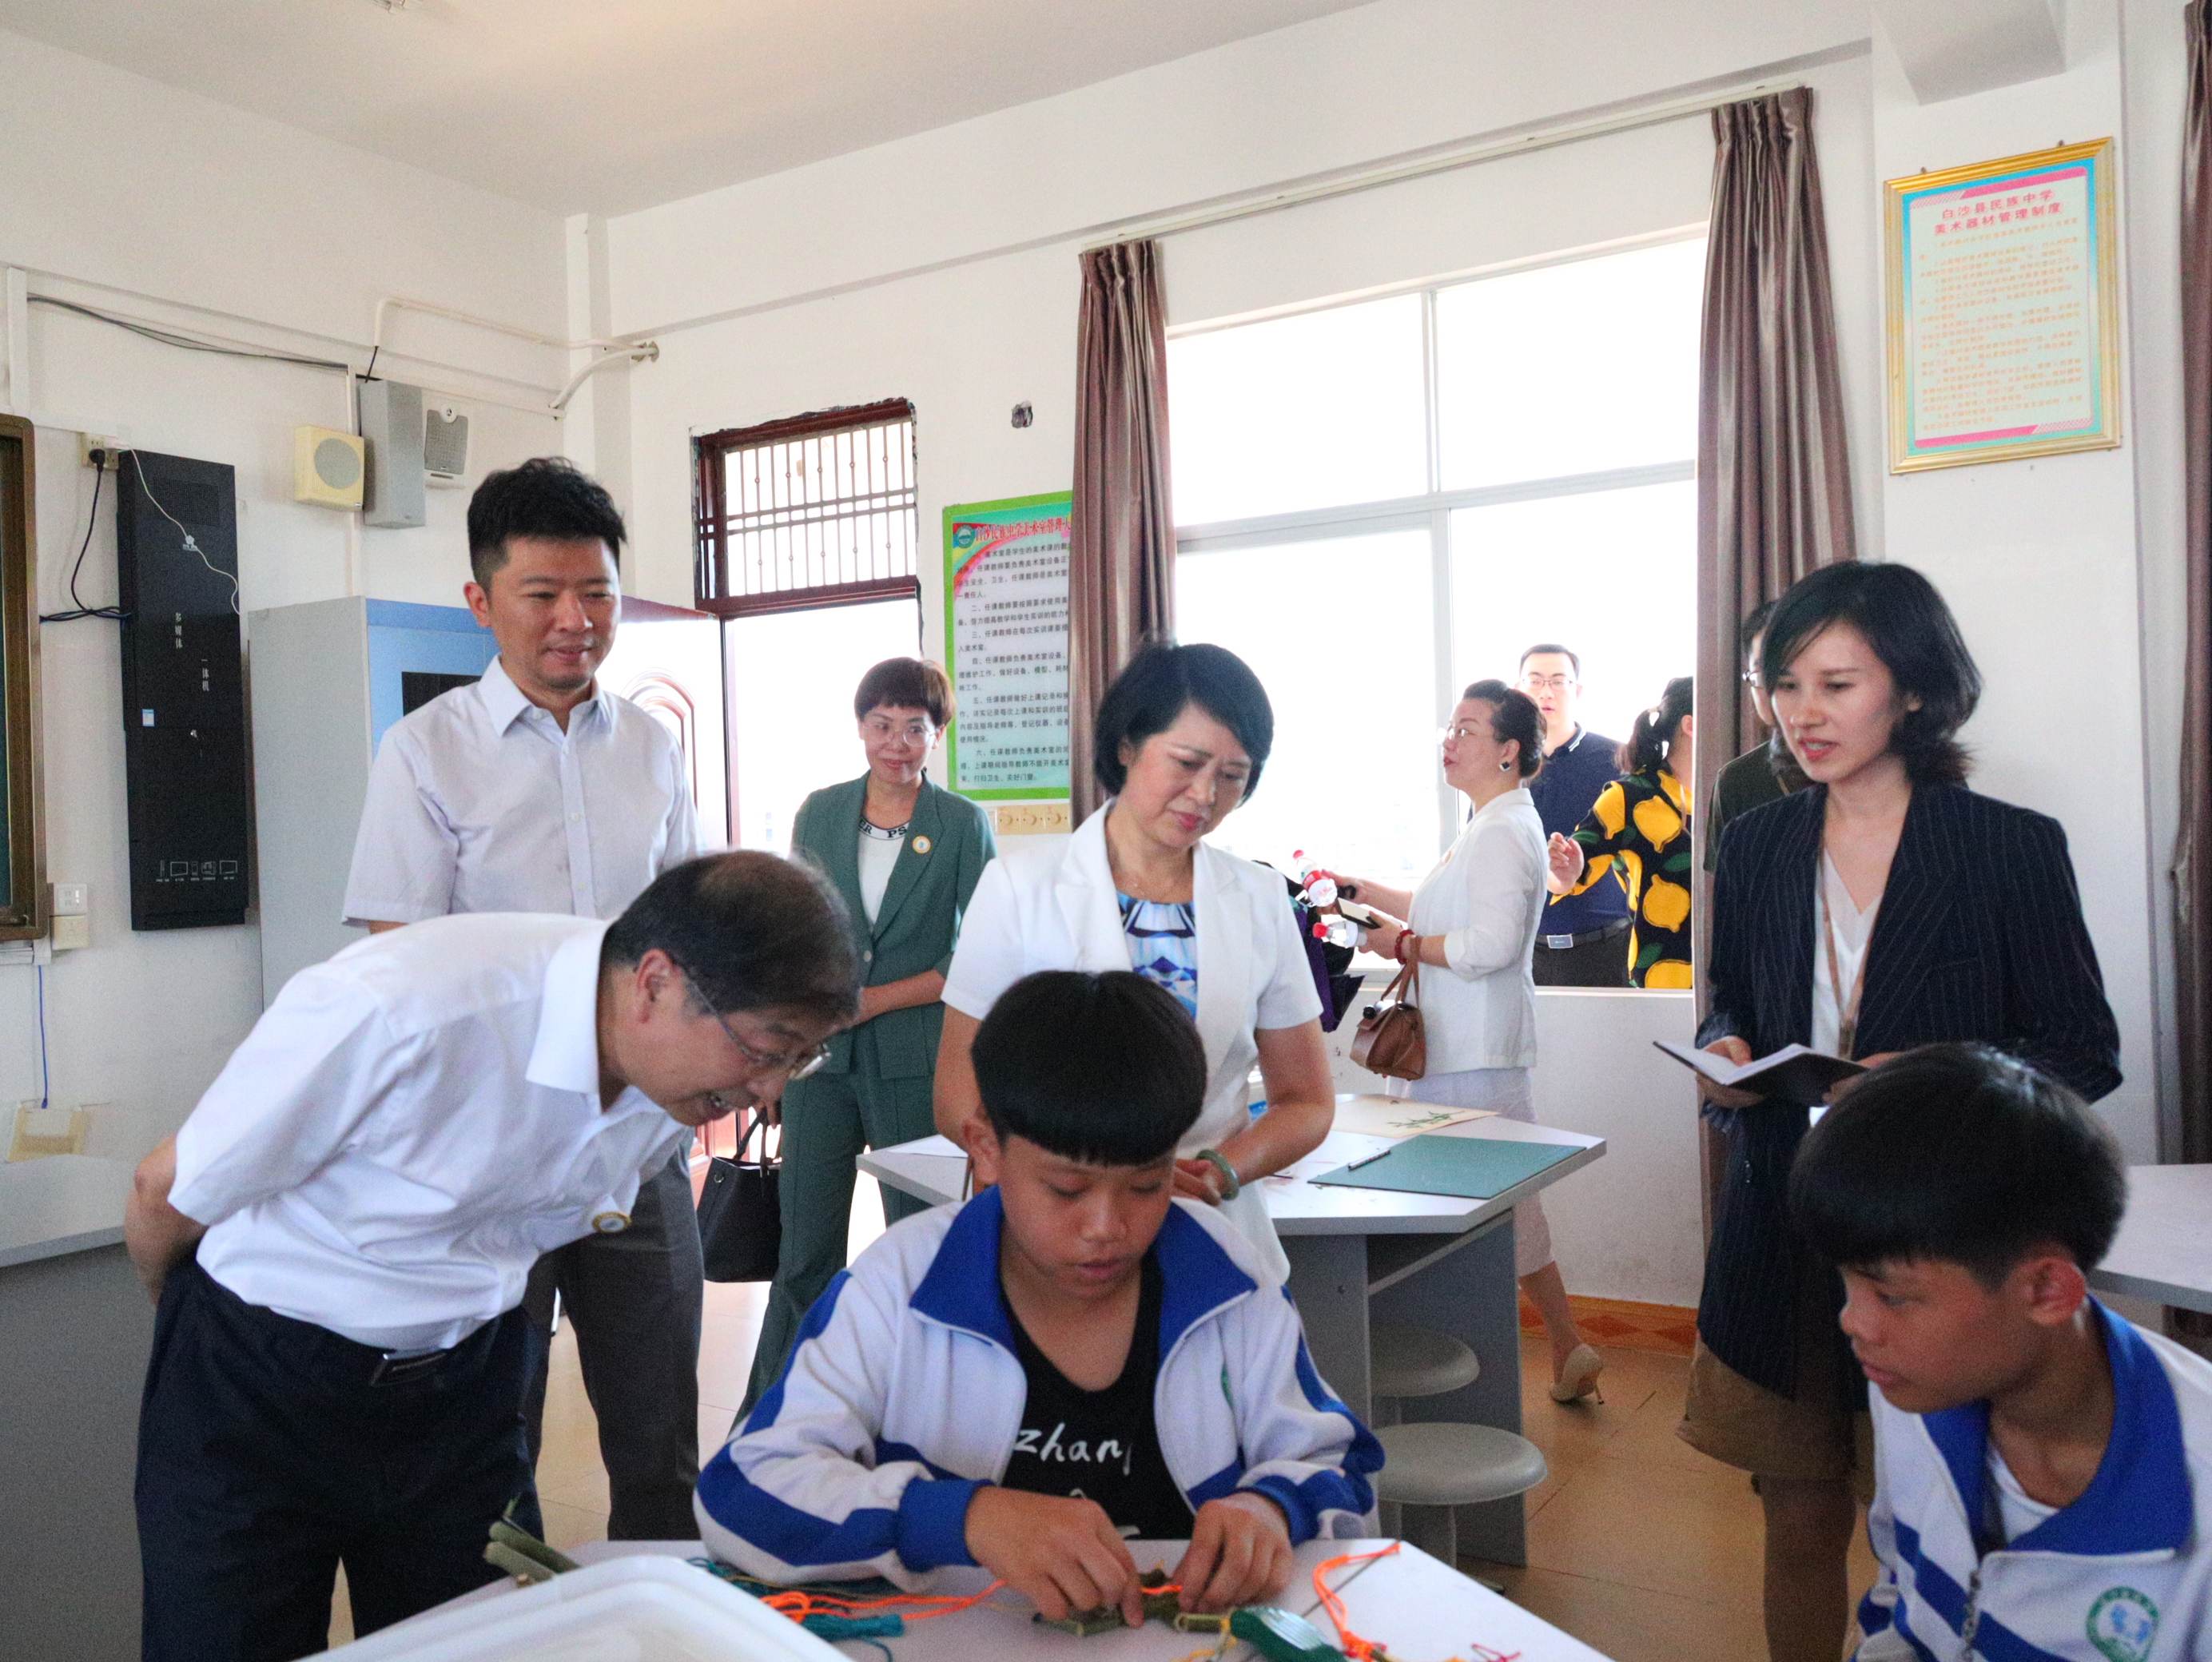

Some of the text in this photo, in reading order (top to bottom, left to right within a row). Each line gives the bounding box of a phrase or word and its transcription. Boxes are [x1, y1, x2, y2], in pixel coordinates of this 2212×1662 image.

[1934, 201, 2063, 236] 美术器材管理制度
[1942, 189, 2055, 220] 白沙县民族中学
[174, 612, 183, 649] 多媒体
